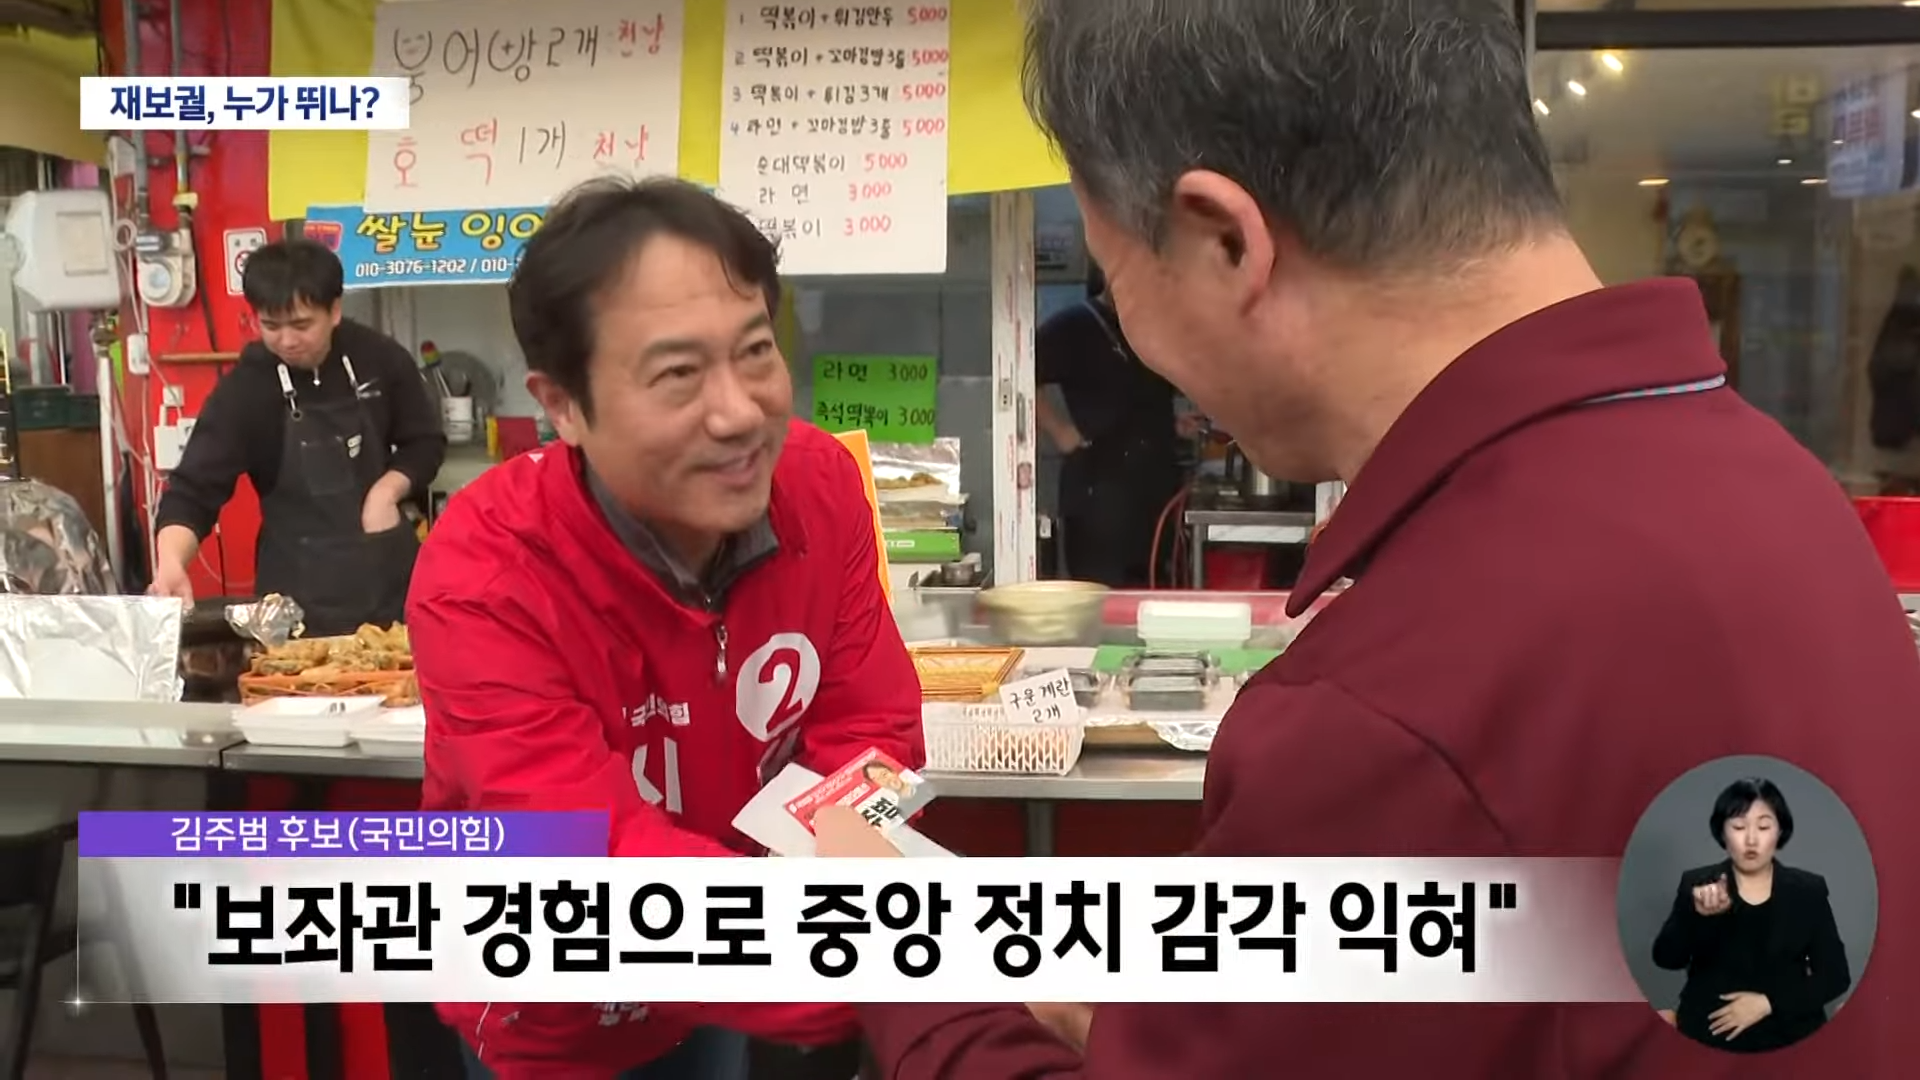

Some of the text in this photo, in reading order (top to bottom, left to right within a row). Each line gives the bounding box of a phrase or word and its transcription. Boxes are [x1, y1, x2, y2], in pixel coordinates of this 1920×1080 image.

[760, 6, 815, 31] 떡볶이
[908, 7, 948, 25] 5000
[752, 47, 808, 68] 떡볶이
[911, 50, 949, 66] 5000
[902, 82, 946, 100] 5000
[903, 118, 946, 137] 5000
[864, 152, 908, 173] 5000
[849, 183, 892, 202] 3000
[843, 215, 892, 237] 3000
[354, 258, 467, 278] 010-3076-1202
[889, 362, 929, 381] 3000
[898, 405, 936, 426] 3000
[757, 647, 805, 736] 2
[1009, 687, 1037, 711] 구운
[1032, 703, 1061, 724] 2개
